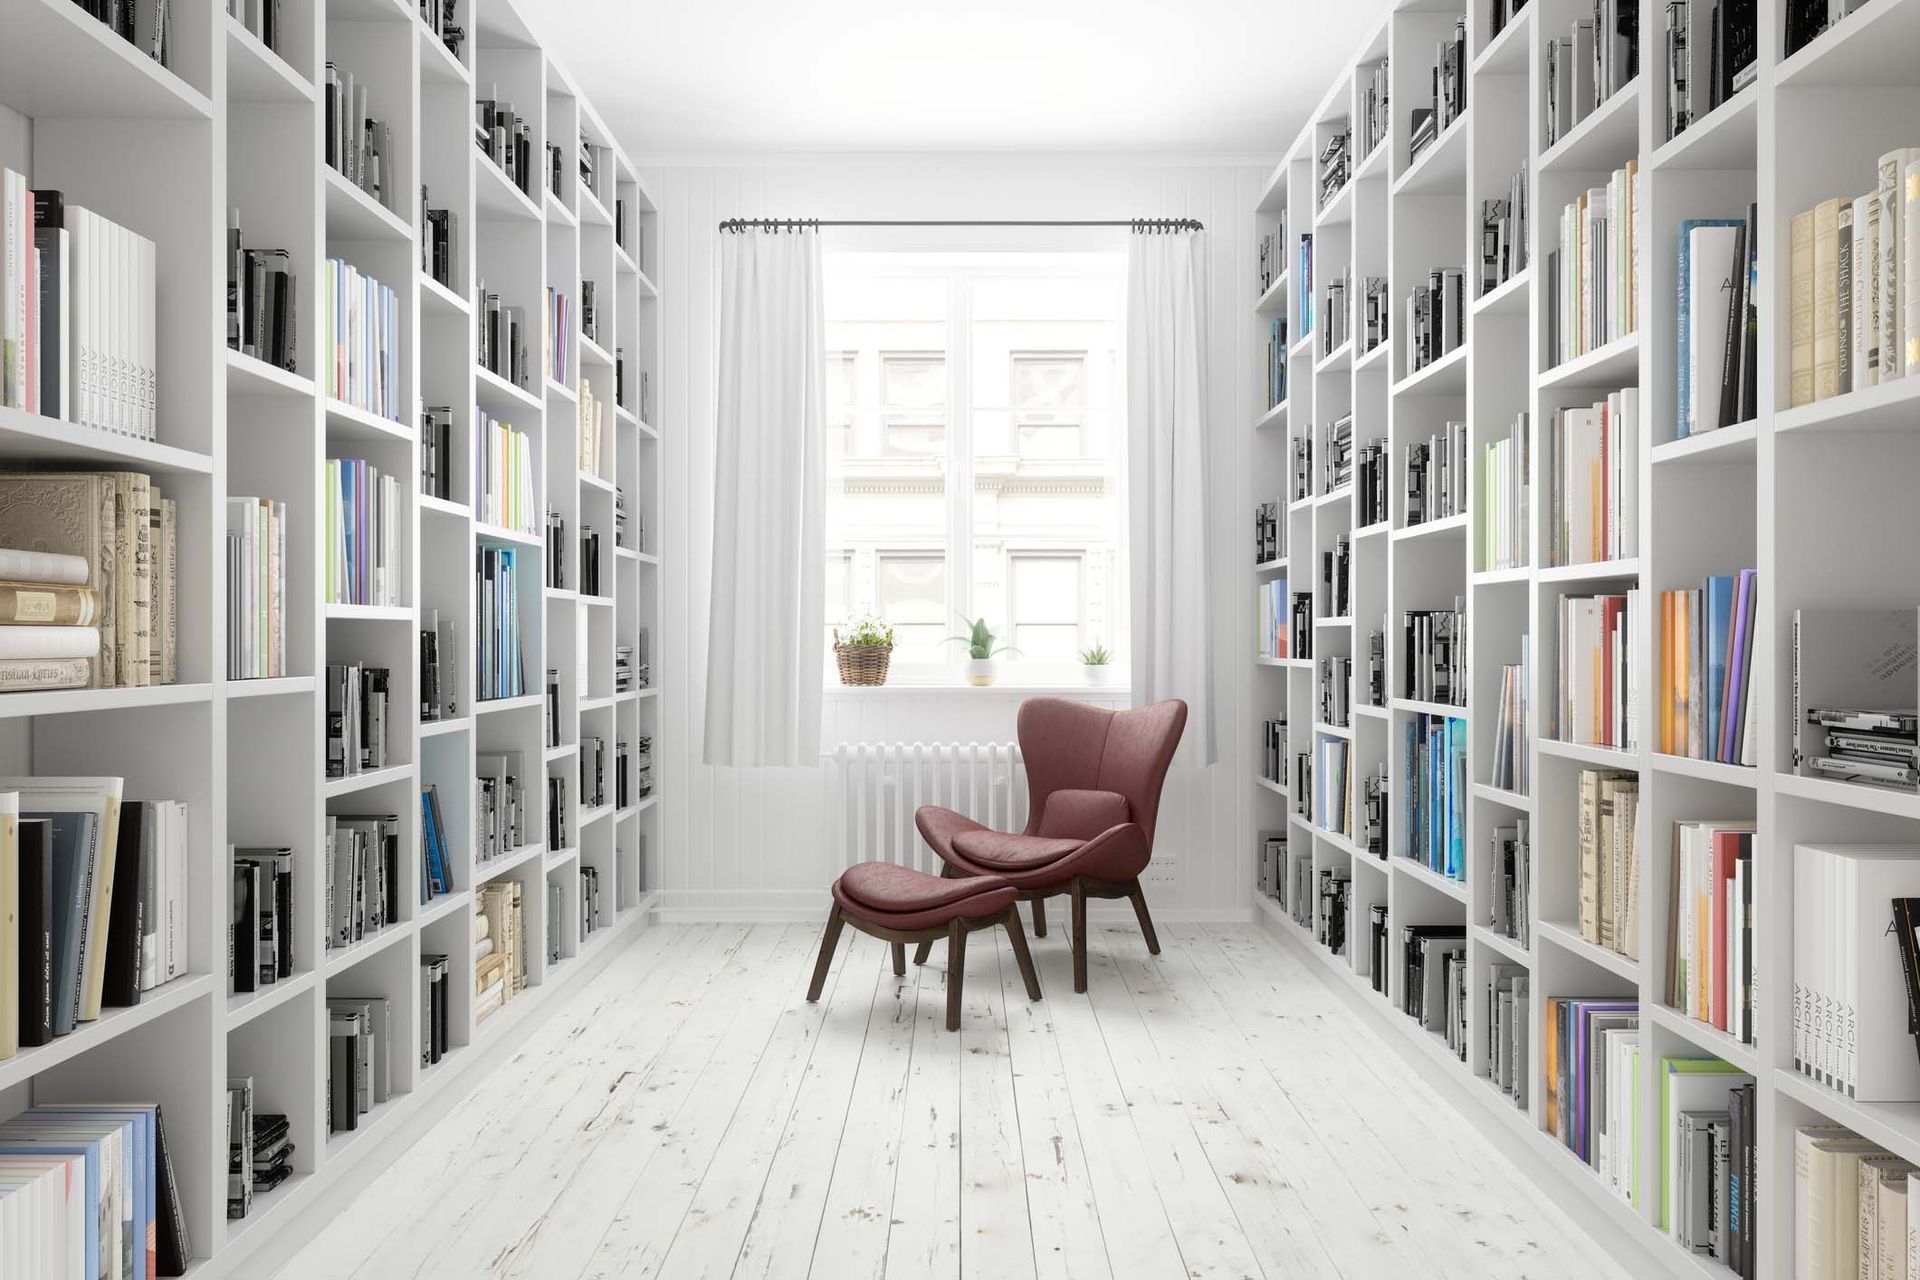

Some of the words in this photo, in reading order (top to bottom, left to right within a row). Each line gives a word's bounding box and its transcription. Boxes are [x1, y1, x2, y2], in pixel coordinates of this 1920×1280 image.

[1839, 243, 1850, 288] SHACK
[1839, 289, 1850, 314] THE
[80, 345, 88, 391] ARCH
[90, 348, 98, 394] ARCH
[1839, 329, 1848, 377] YOUNG
[120, 359, 128, 403] ARCH
[1730, 1173, 1739, 1233] FINANCE
